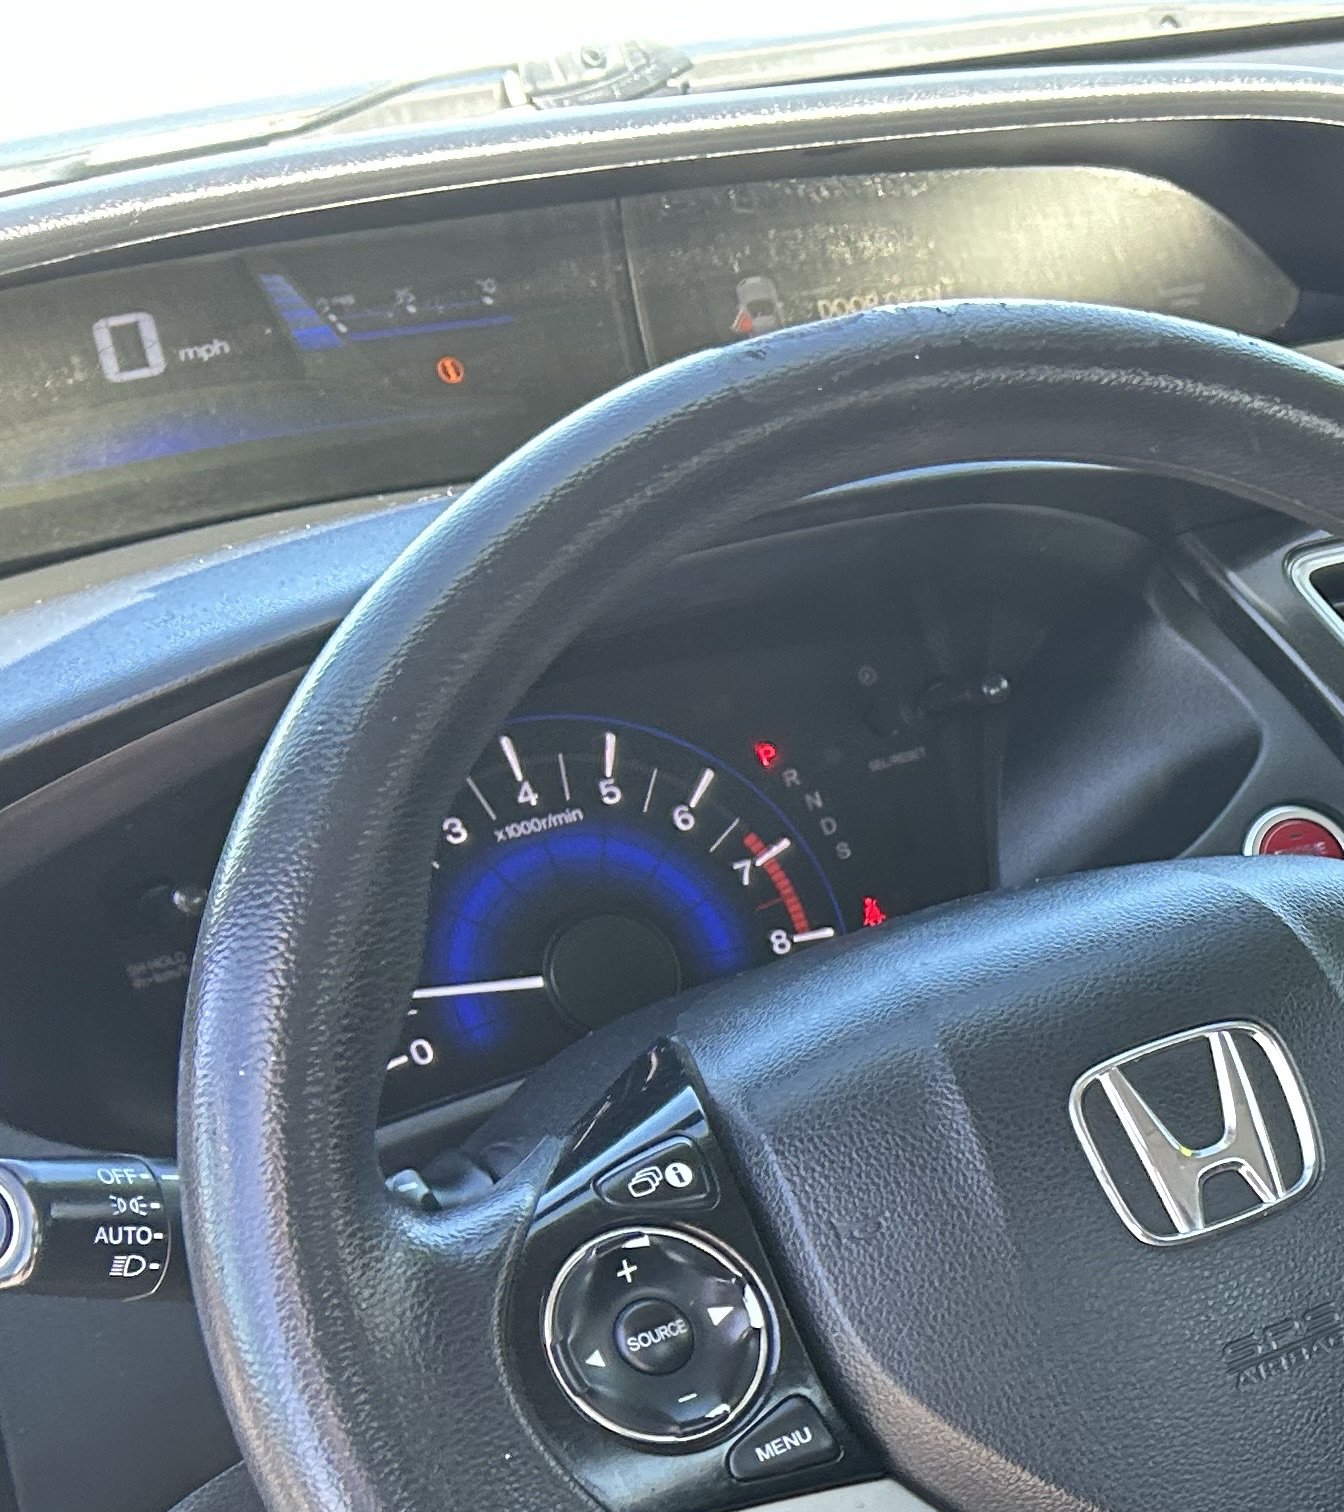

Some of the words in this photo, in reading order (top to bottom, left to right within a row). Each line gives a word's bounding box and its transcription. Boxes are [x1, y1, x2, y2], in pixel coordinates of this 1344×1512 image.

[92, 312, 166, 384] 0
[178, 338, 231, 362] mph
[753, 741, 777, 768] P
[598, 777, 622, 805] 5
[782, 768, 800, 787] R
[517, 780, 539, 806] 4
[804, 791, 824, 811] N
[442, 816, 469, 845] 3
[672, 804, 696, 831] 6
[819, 816, 838, 836] D
[732, 859, 752, 886] 7
[770, 928, 792, 955] 8
[409, 1038, 434, 1066] 0
[96, 1168, 137, 1185] OFF
[94, 1226, 152, 1245] AUTO
[627, 1319, 688, 1352] SOURCE
[755, 1426, 813, 1462] MENU
